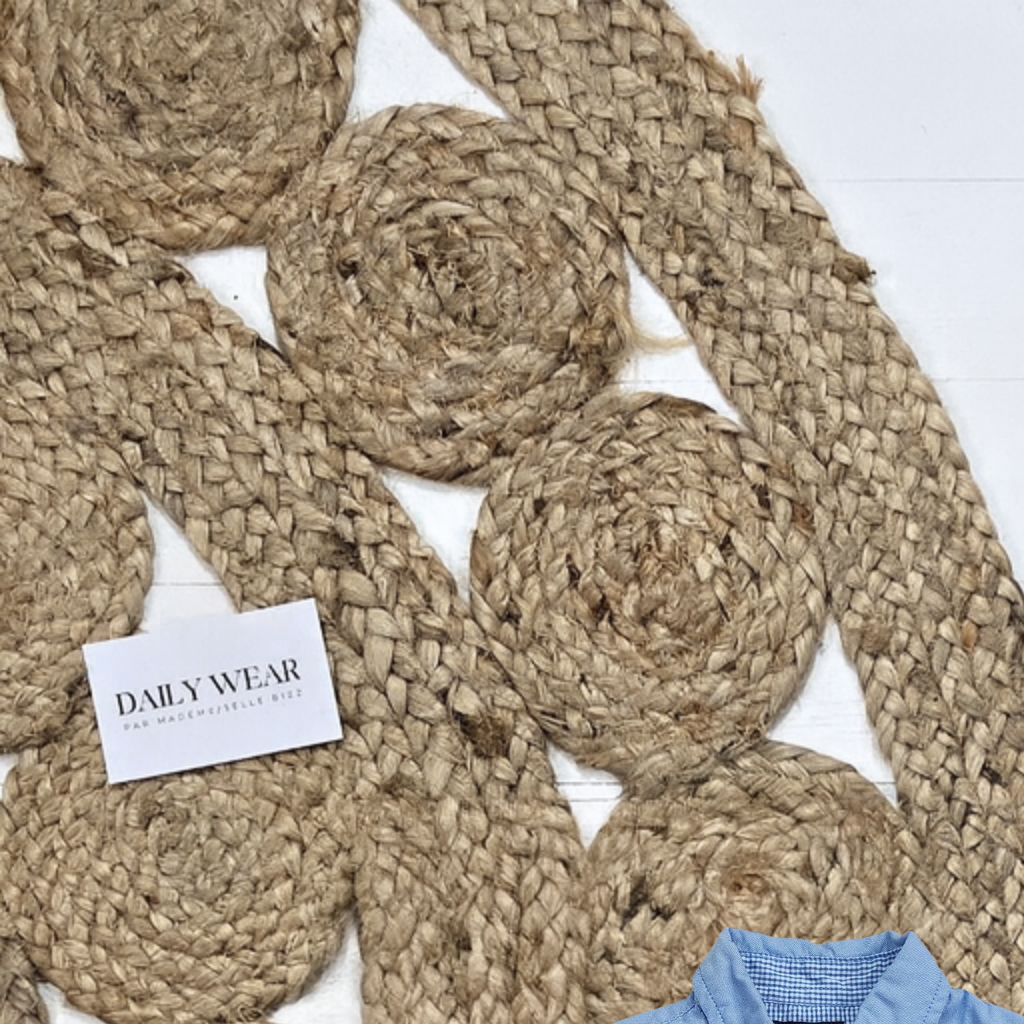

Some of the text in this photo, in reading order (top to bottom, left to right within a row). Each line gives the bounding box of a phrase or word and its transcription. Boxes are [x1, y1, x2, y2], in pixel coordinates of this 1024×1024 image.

[115, 658, 301, 716] DAILY WEAR
[123, 719, 151, 731] PAR
